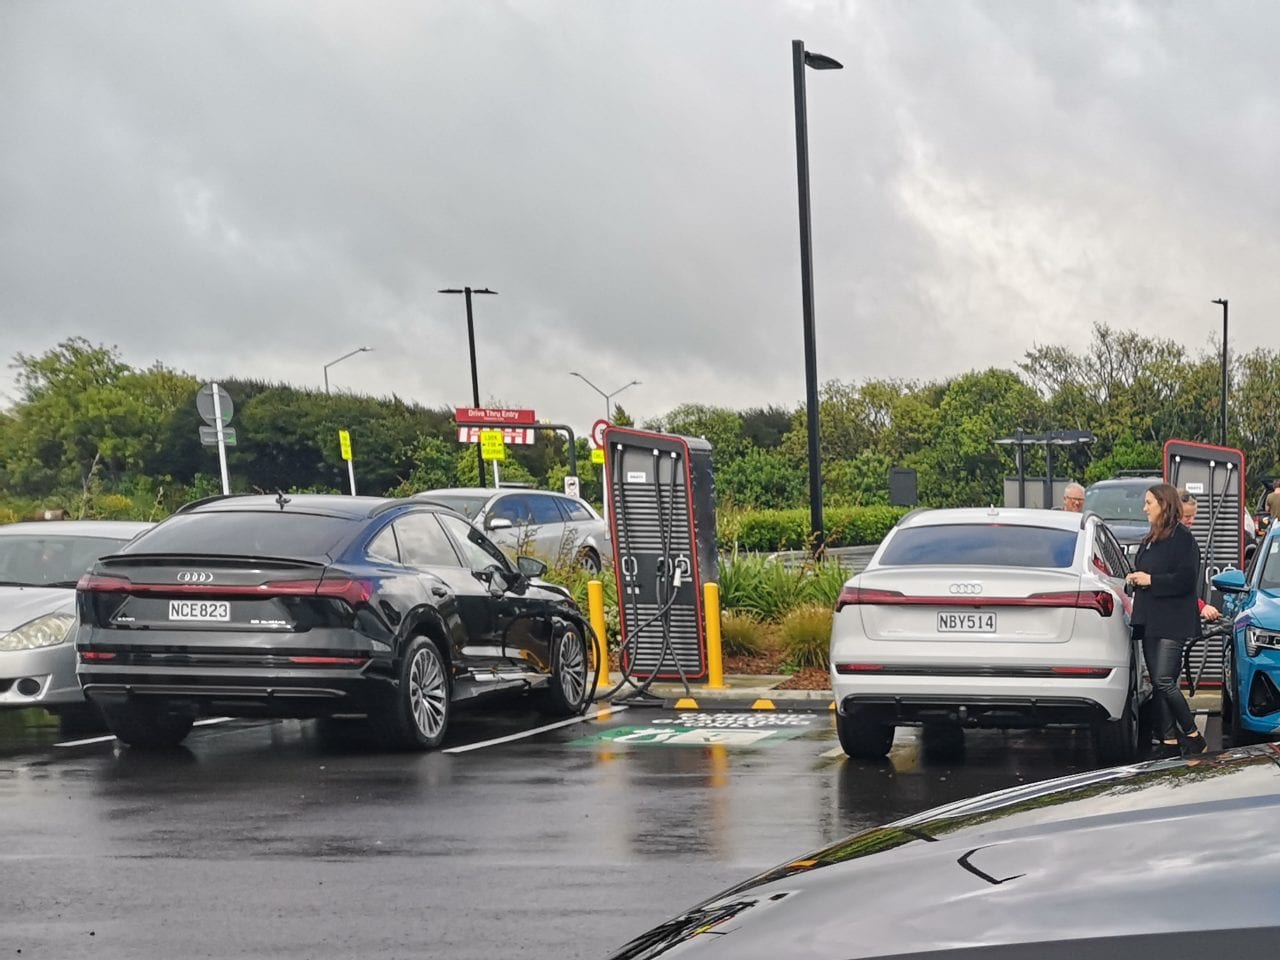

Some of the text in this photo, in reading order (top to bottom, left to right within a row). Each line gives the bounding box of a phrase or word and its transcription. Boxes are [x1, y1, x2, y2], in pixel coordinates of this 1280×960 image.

[468, 409, 485, 417] Drive
[486, 410, 501, 418] Thru
[502, 411, 519, 419] Entry
[171, 603, 228, 618] NCE823
[939, 615, 994, 629] NBY514
